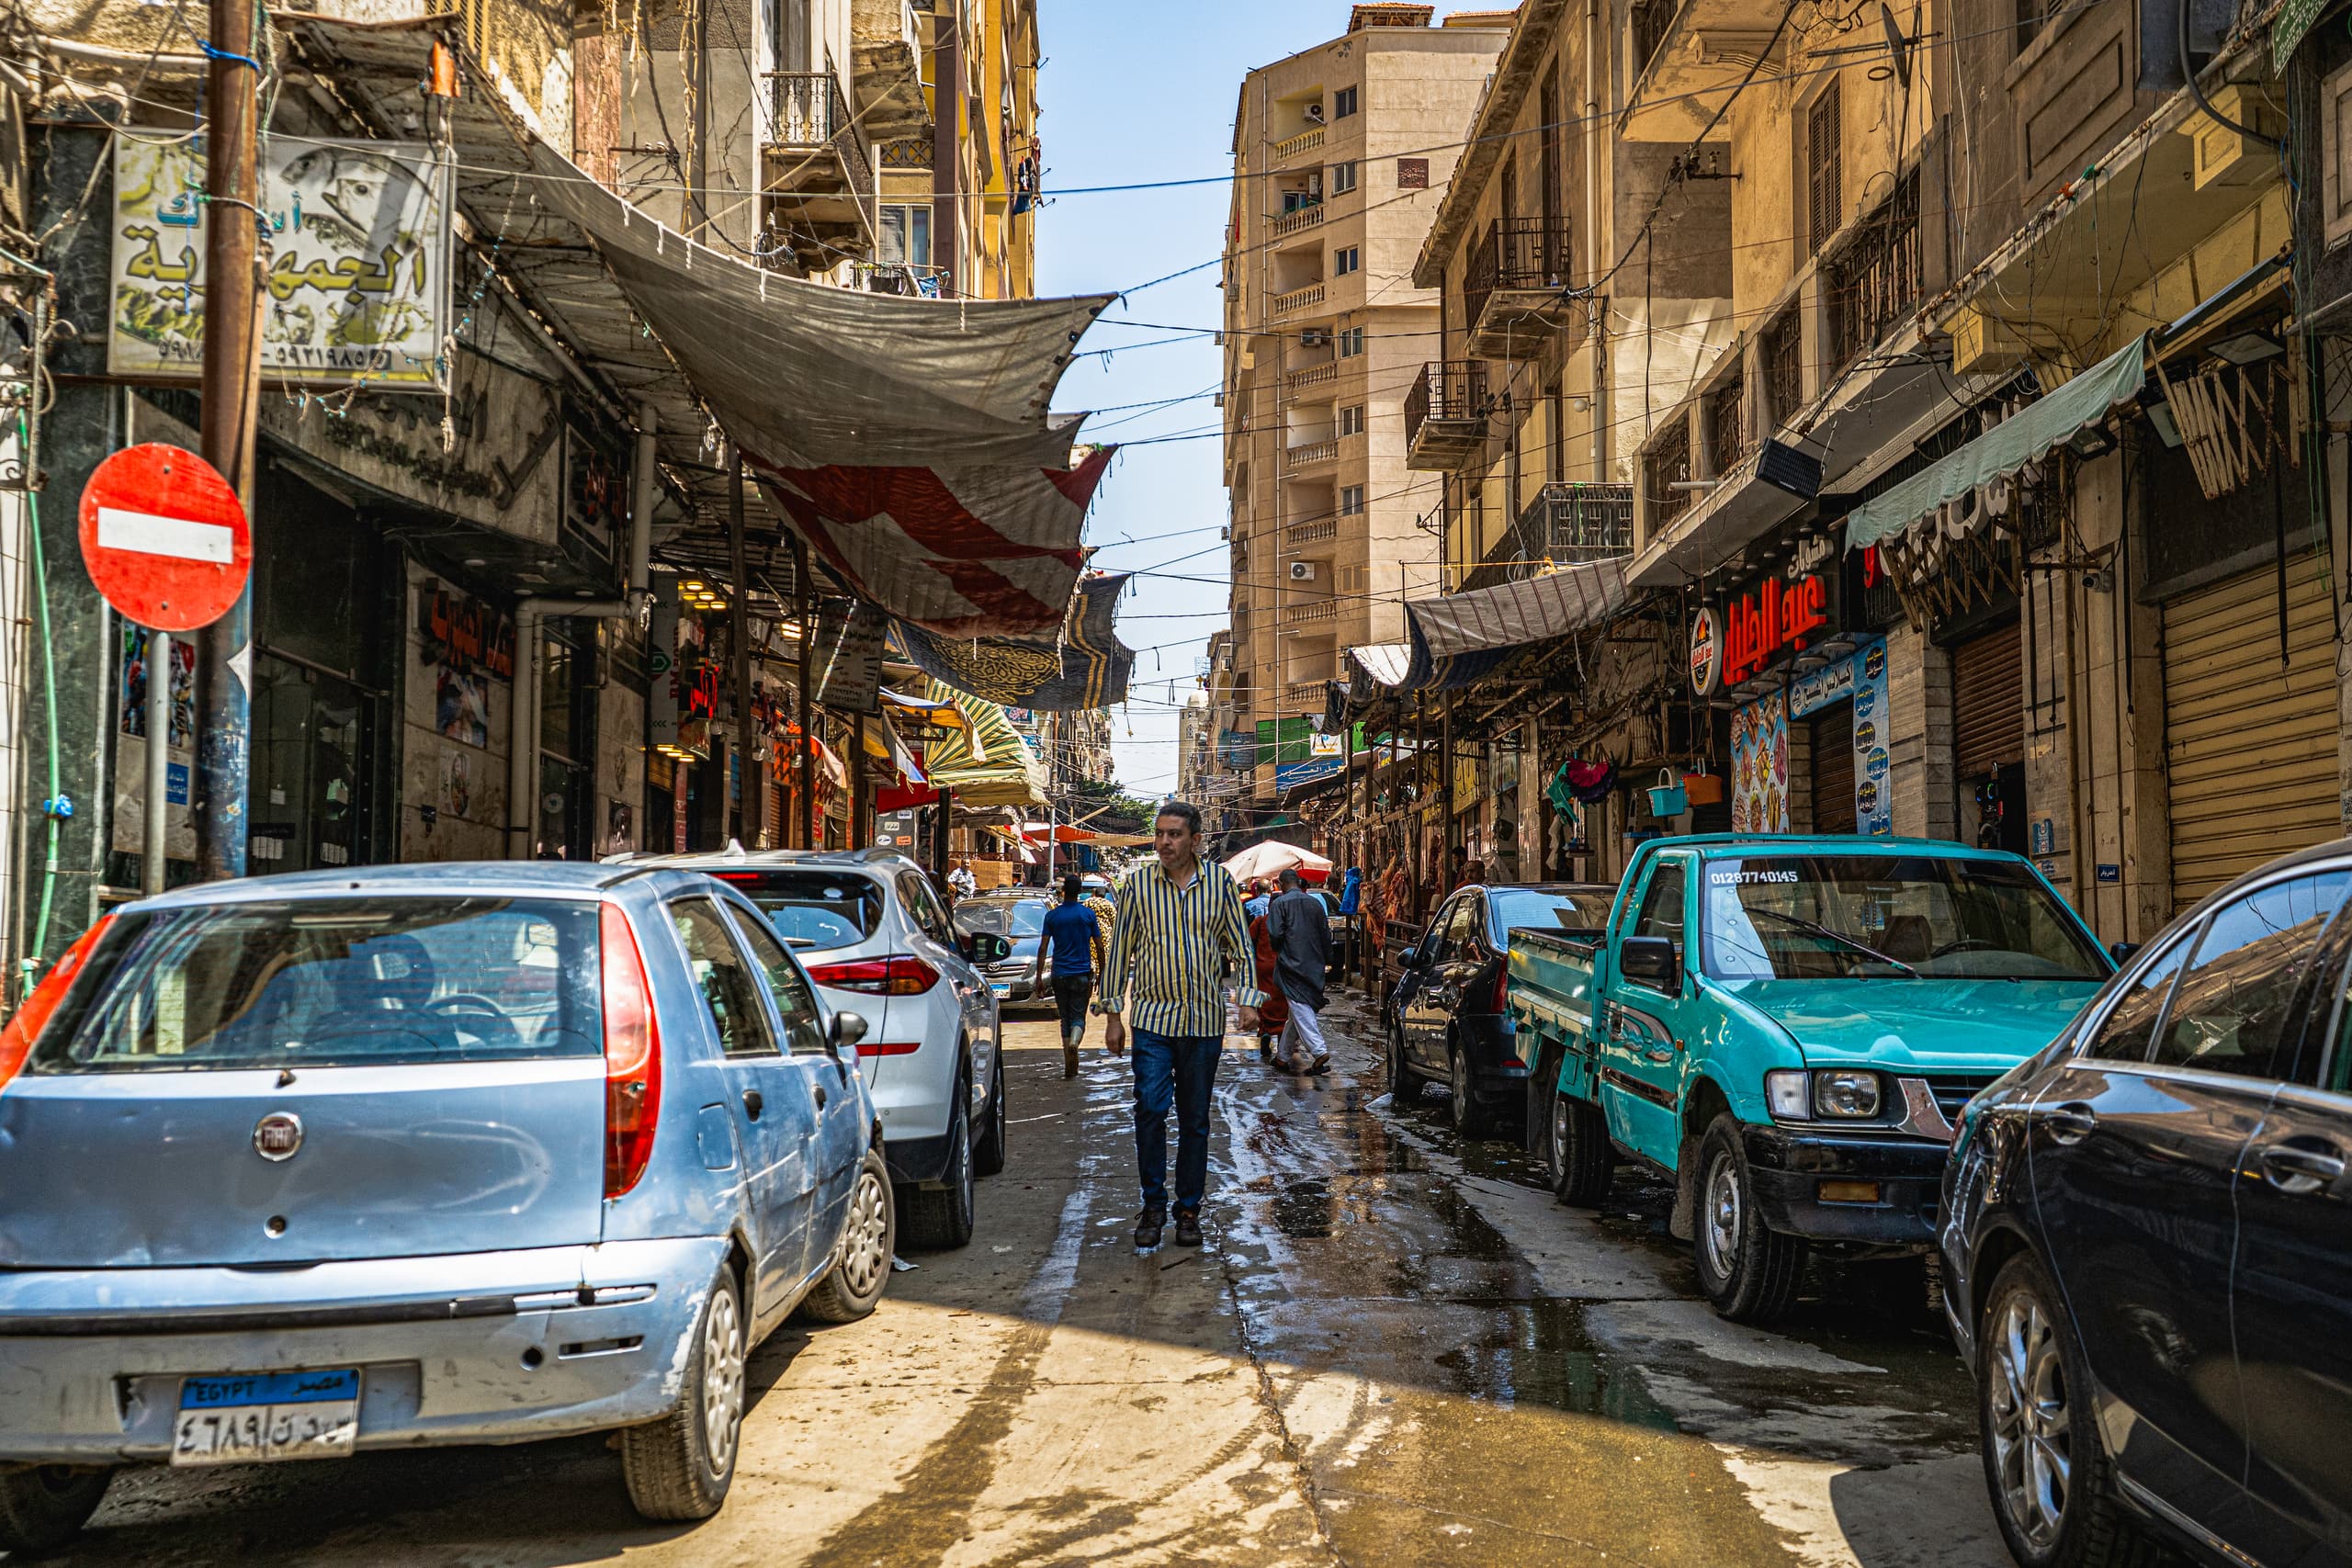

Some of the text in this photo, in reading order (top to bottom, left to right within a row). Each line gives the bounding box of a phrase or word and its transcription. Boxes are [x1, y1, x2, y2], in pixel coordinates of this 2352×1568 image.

[121, 225, 425, 306] الجمهية
[1787, 535, 1832, 581] مشويات
[1723, 574, 1826, 687] عبد الجليل
[1711, 871, 1798, 885] 01287740145
[264, 1125, 293, 1147] FIAT
[196, 1381, 255, 1402] EGYPT
[292, 1376, 344, 1396] مصر
[178, 1415, 260, 1454] ٤٦٨٩
